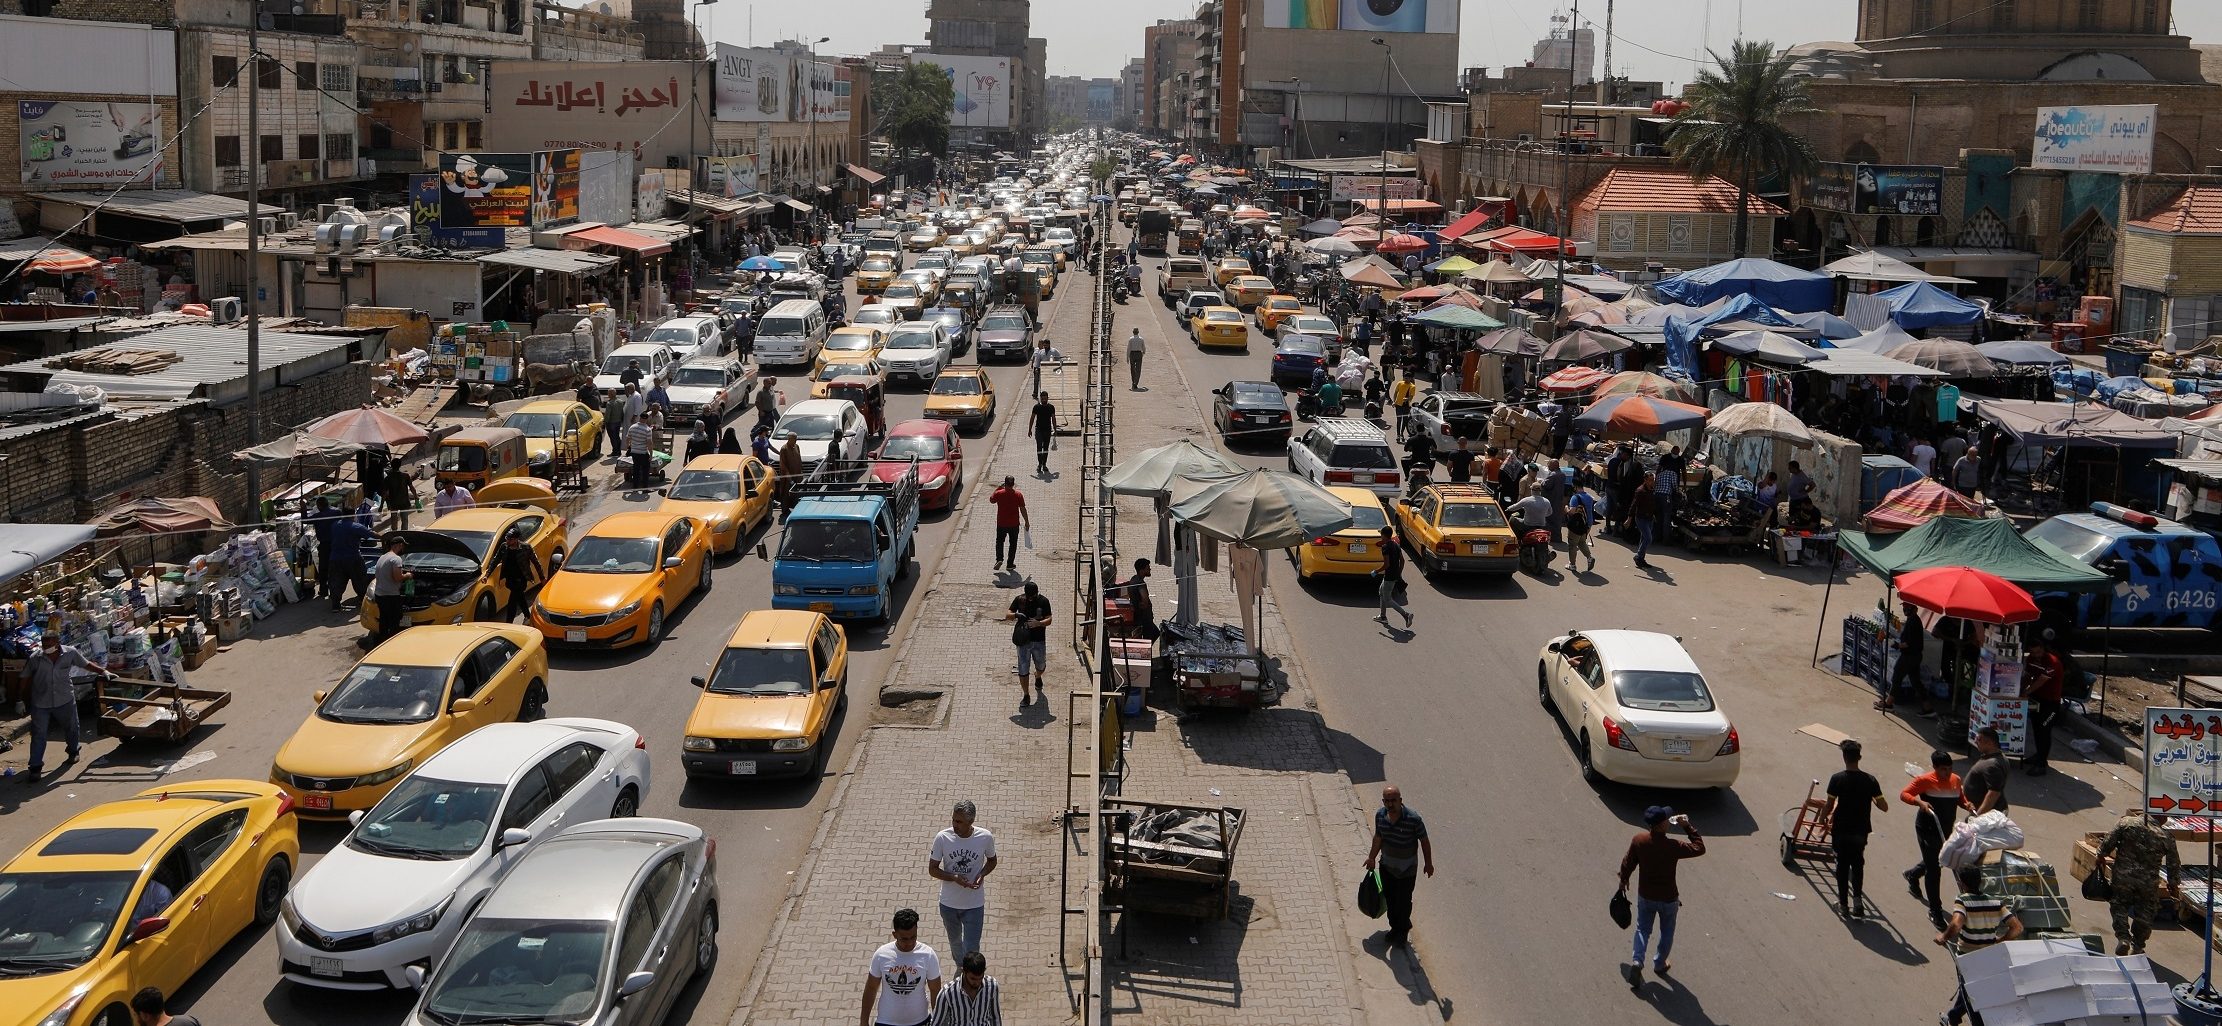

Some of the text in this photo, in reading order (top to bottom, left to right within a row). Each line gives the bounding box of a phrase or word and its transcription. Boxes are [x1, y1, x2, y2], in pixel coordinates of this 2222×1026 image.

[516, 80, 605, 113] إعلانك
[2166, 590, 2215, 610] 6426
[2153, 714, 2205, 741] وقوف
[2153, 743, 2192, 766] العربي
